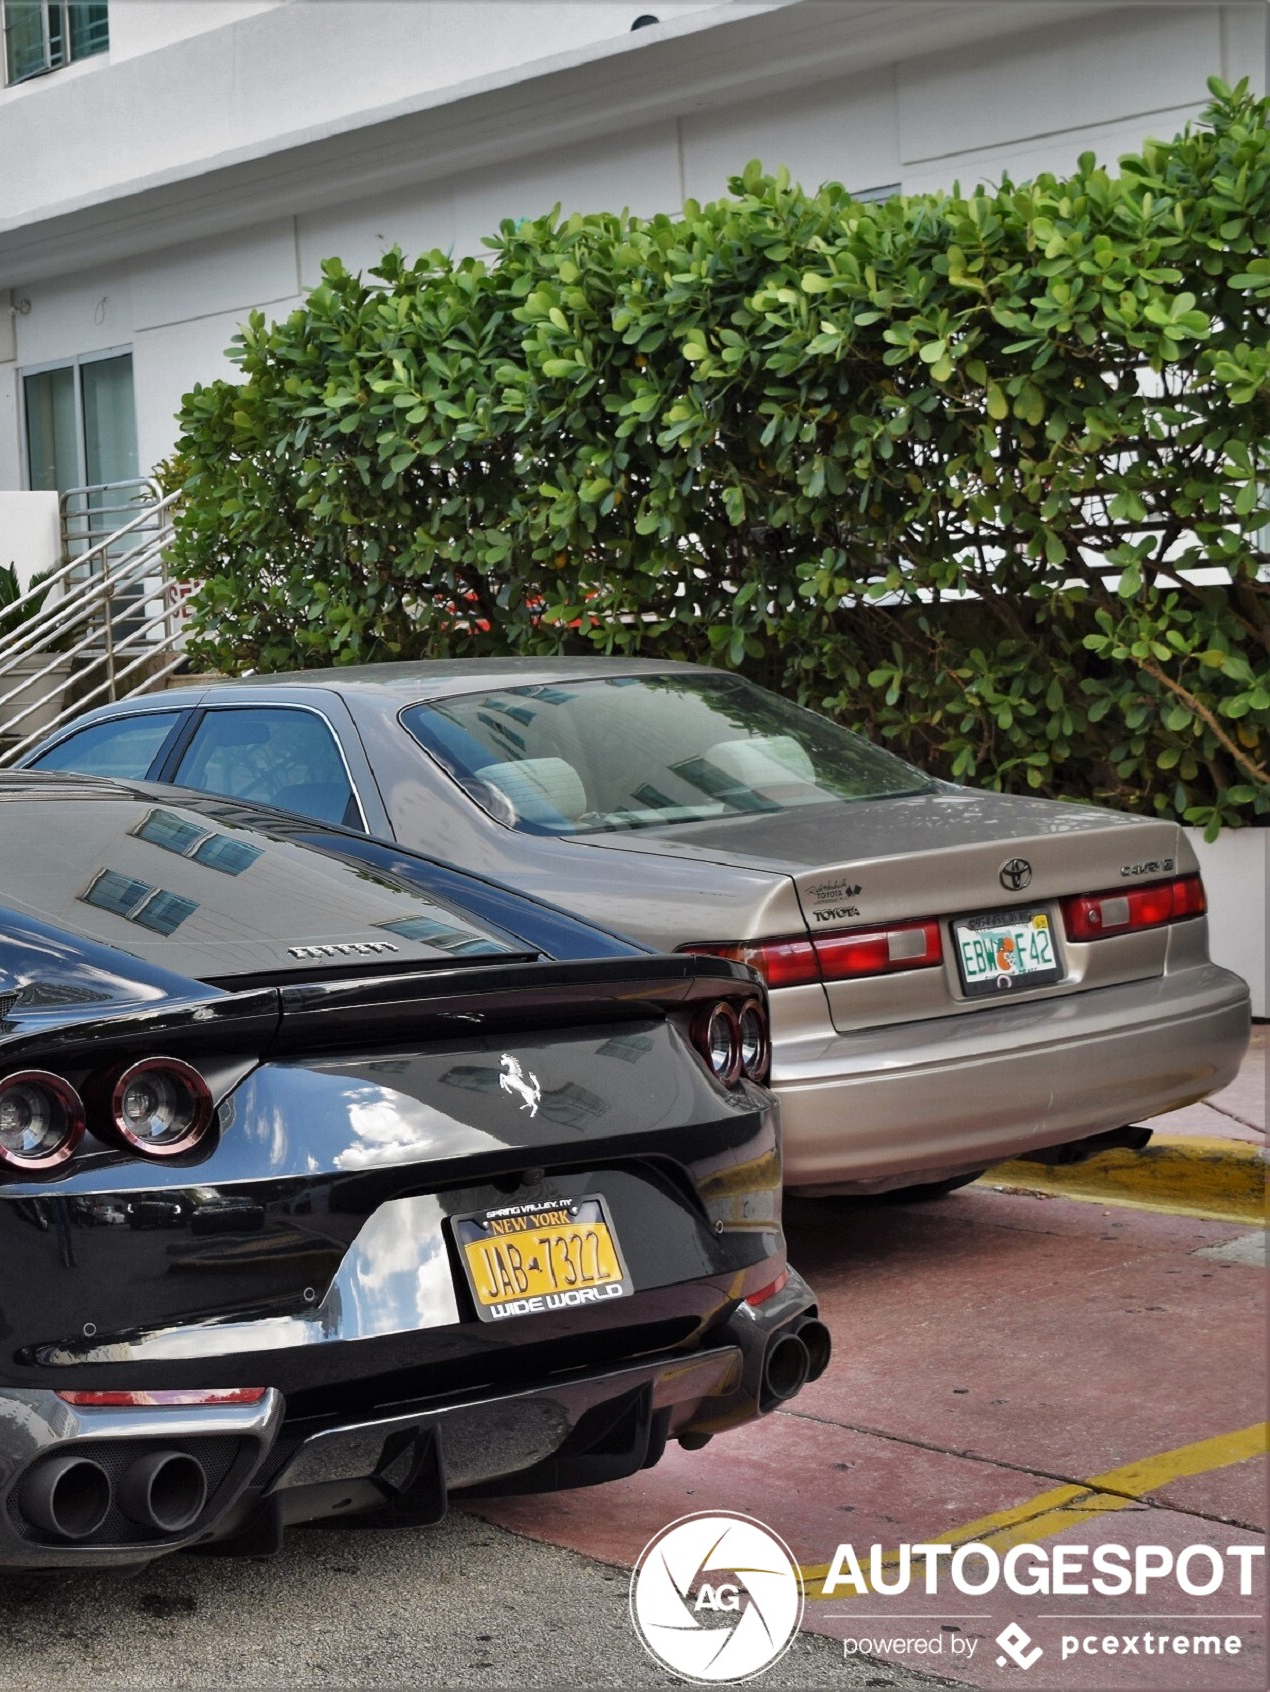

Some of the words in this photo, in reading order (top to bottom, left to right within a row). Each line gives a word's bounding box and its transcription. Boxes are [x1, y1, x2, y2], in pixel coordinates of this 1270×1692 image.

[816, 889, 843, 900] TOYOTA
[812, 905, 861, 922] TOYOTA
[486, 1205, 521, 1219] SPRING
[559, 1198, 574, 1207] NY
[491, 1216, 527, 1237] NEW
[532, 1208, 572, 1228] YORK
[490, 1297, 546, 1320] WIDE
[545, 1283, 624, 1309] WORLD
